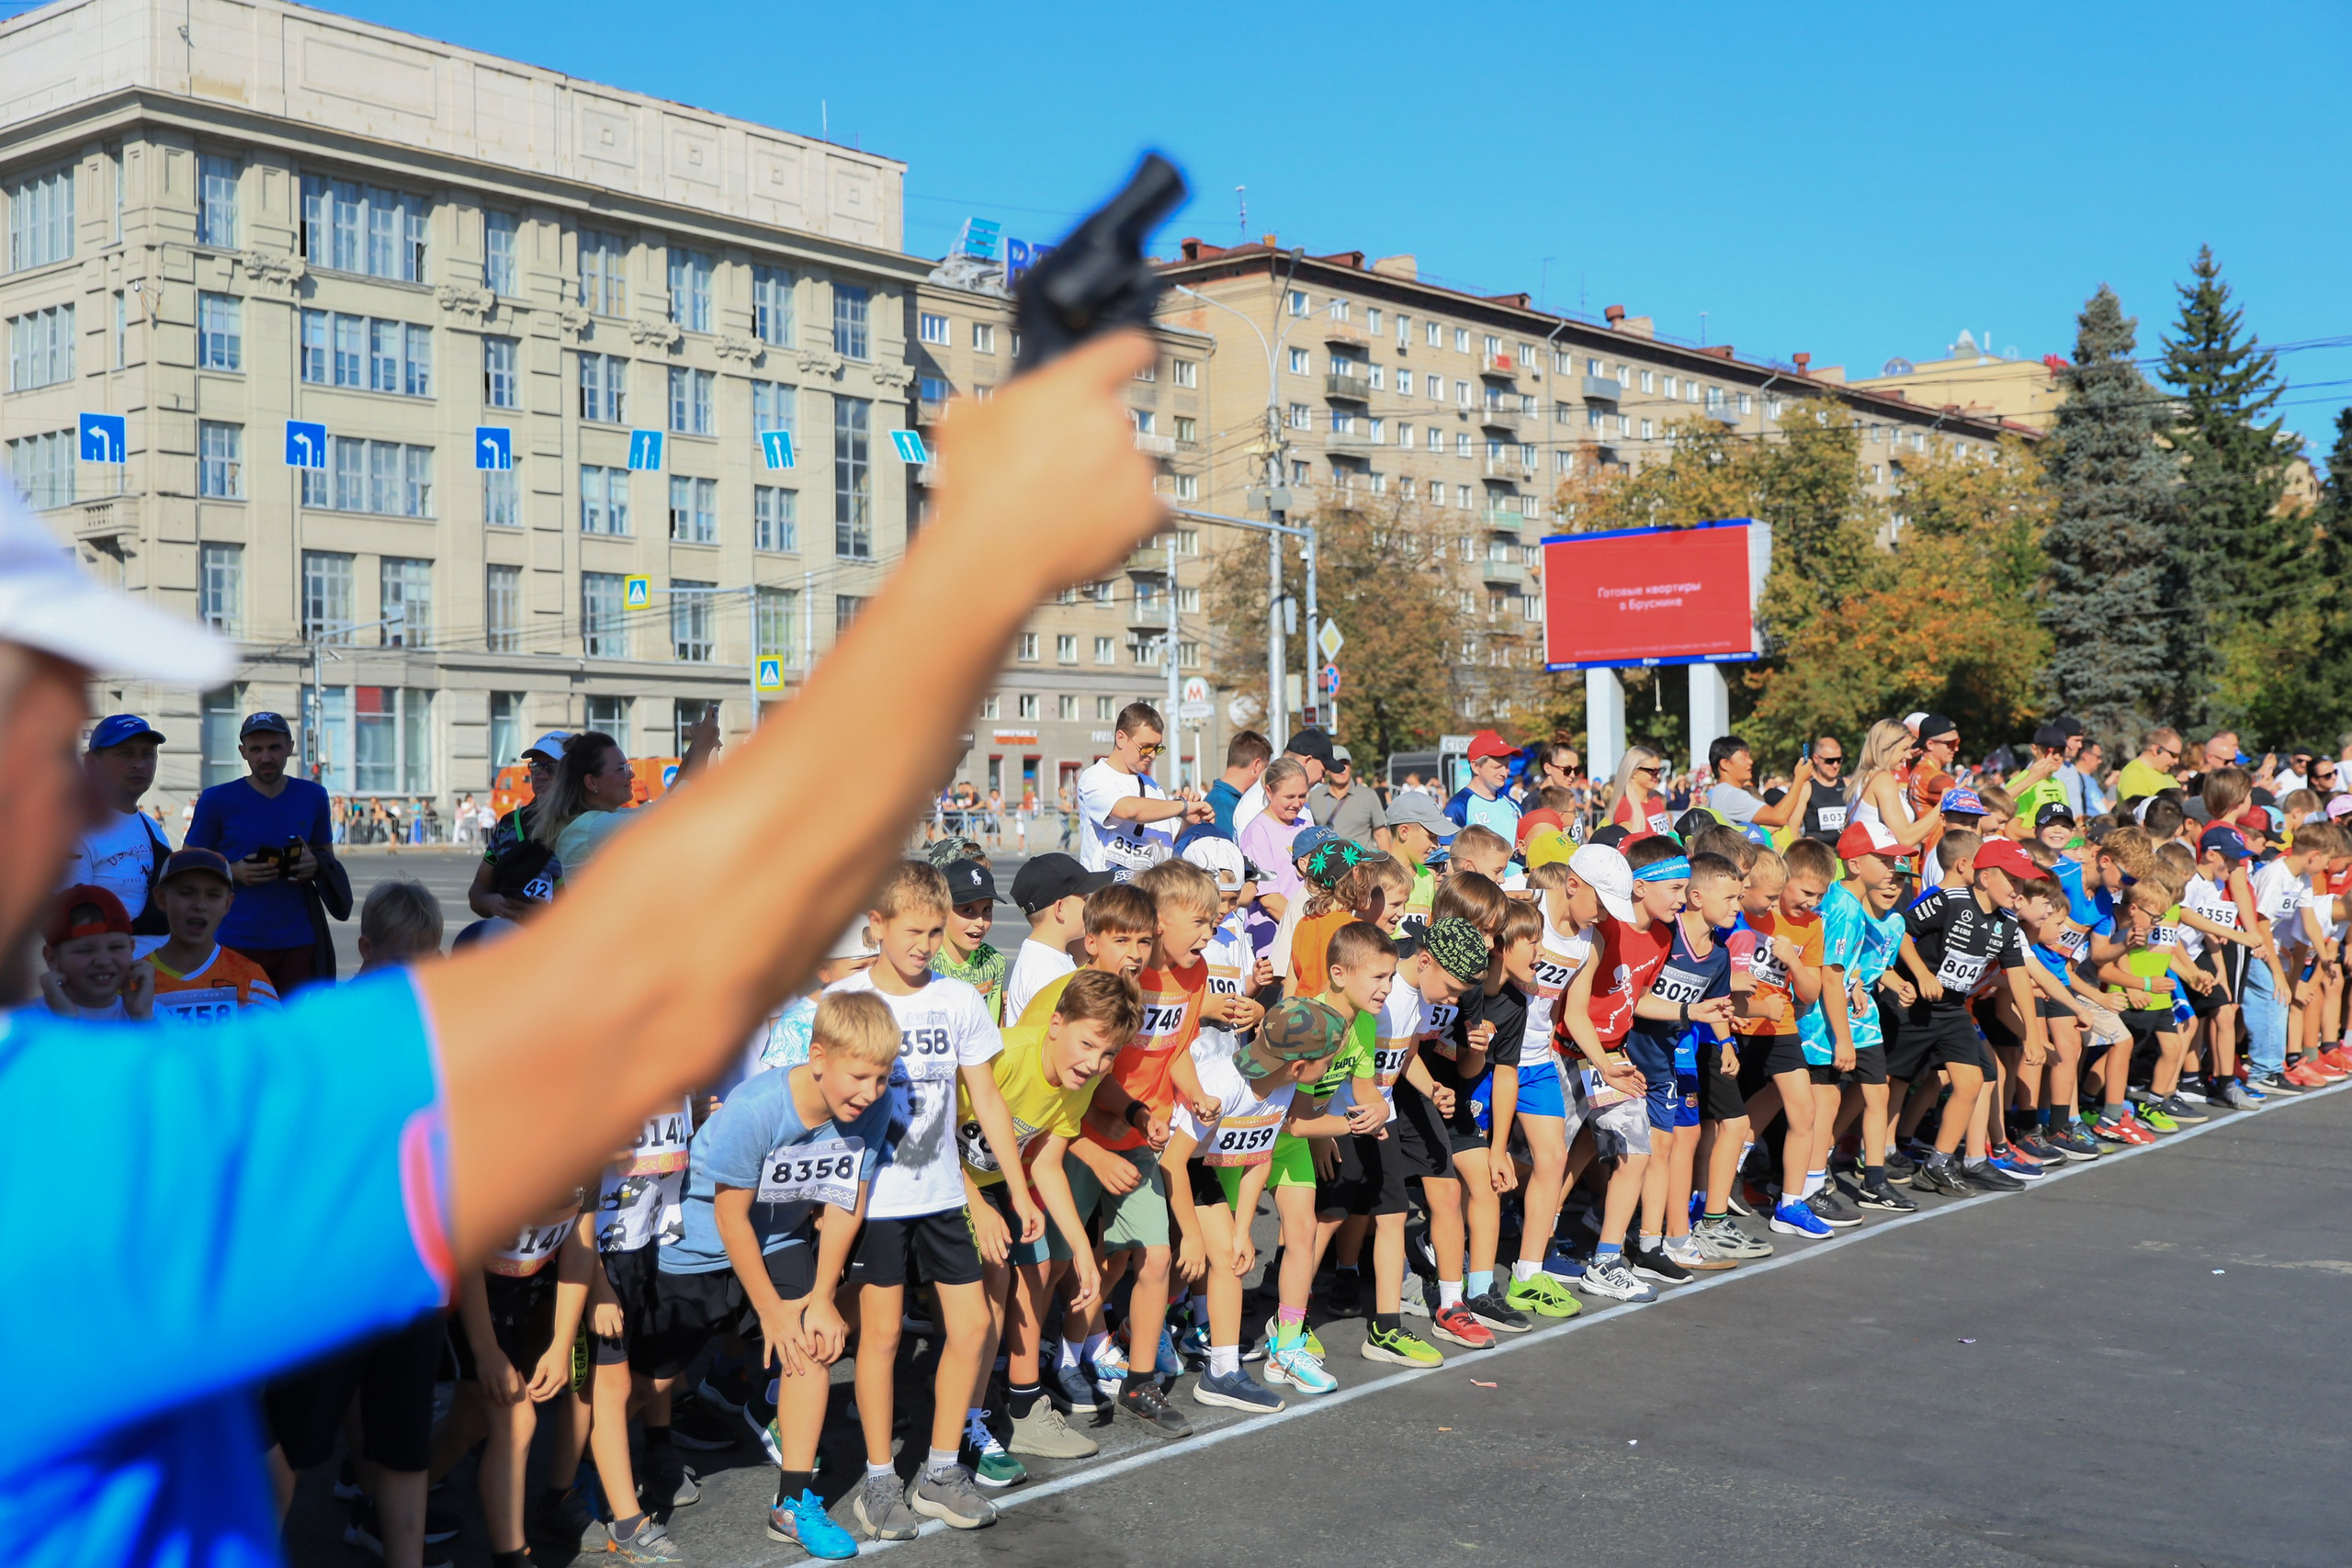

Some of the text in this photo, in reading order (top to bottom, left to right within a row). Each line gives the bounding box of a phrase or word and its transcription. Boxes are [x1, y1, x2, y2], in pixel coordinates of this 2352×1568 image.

[1598, 582, 1702, 599] Готовые квартиры
[1187, 684, 1204, 702] М
[1114, 836, 1154, 858] 8354
[2198, 907, 2233, 923] 8355
[1219, 1127, 1273, 1150] 8159
[772, 1155, 854, 1183] 8358
[575, 1340, 586, 1370] GAME
